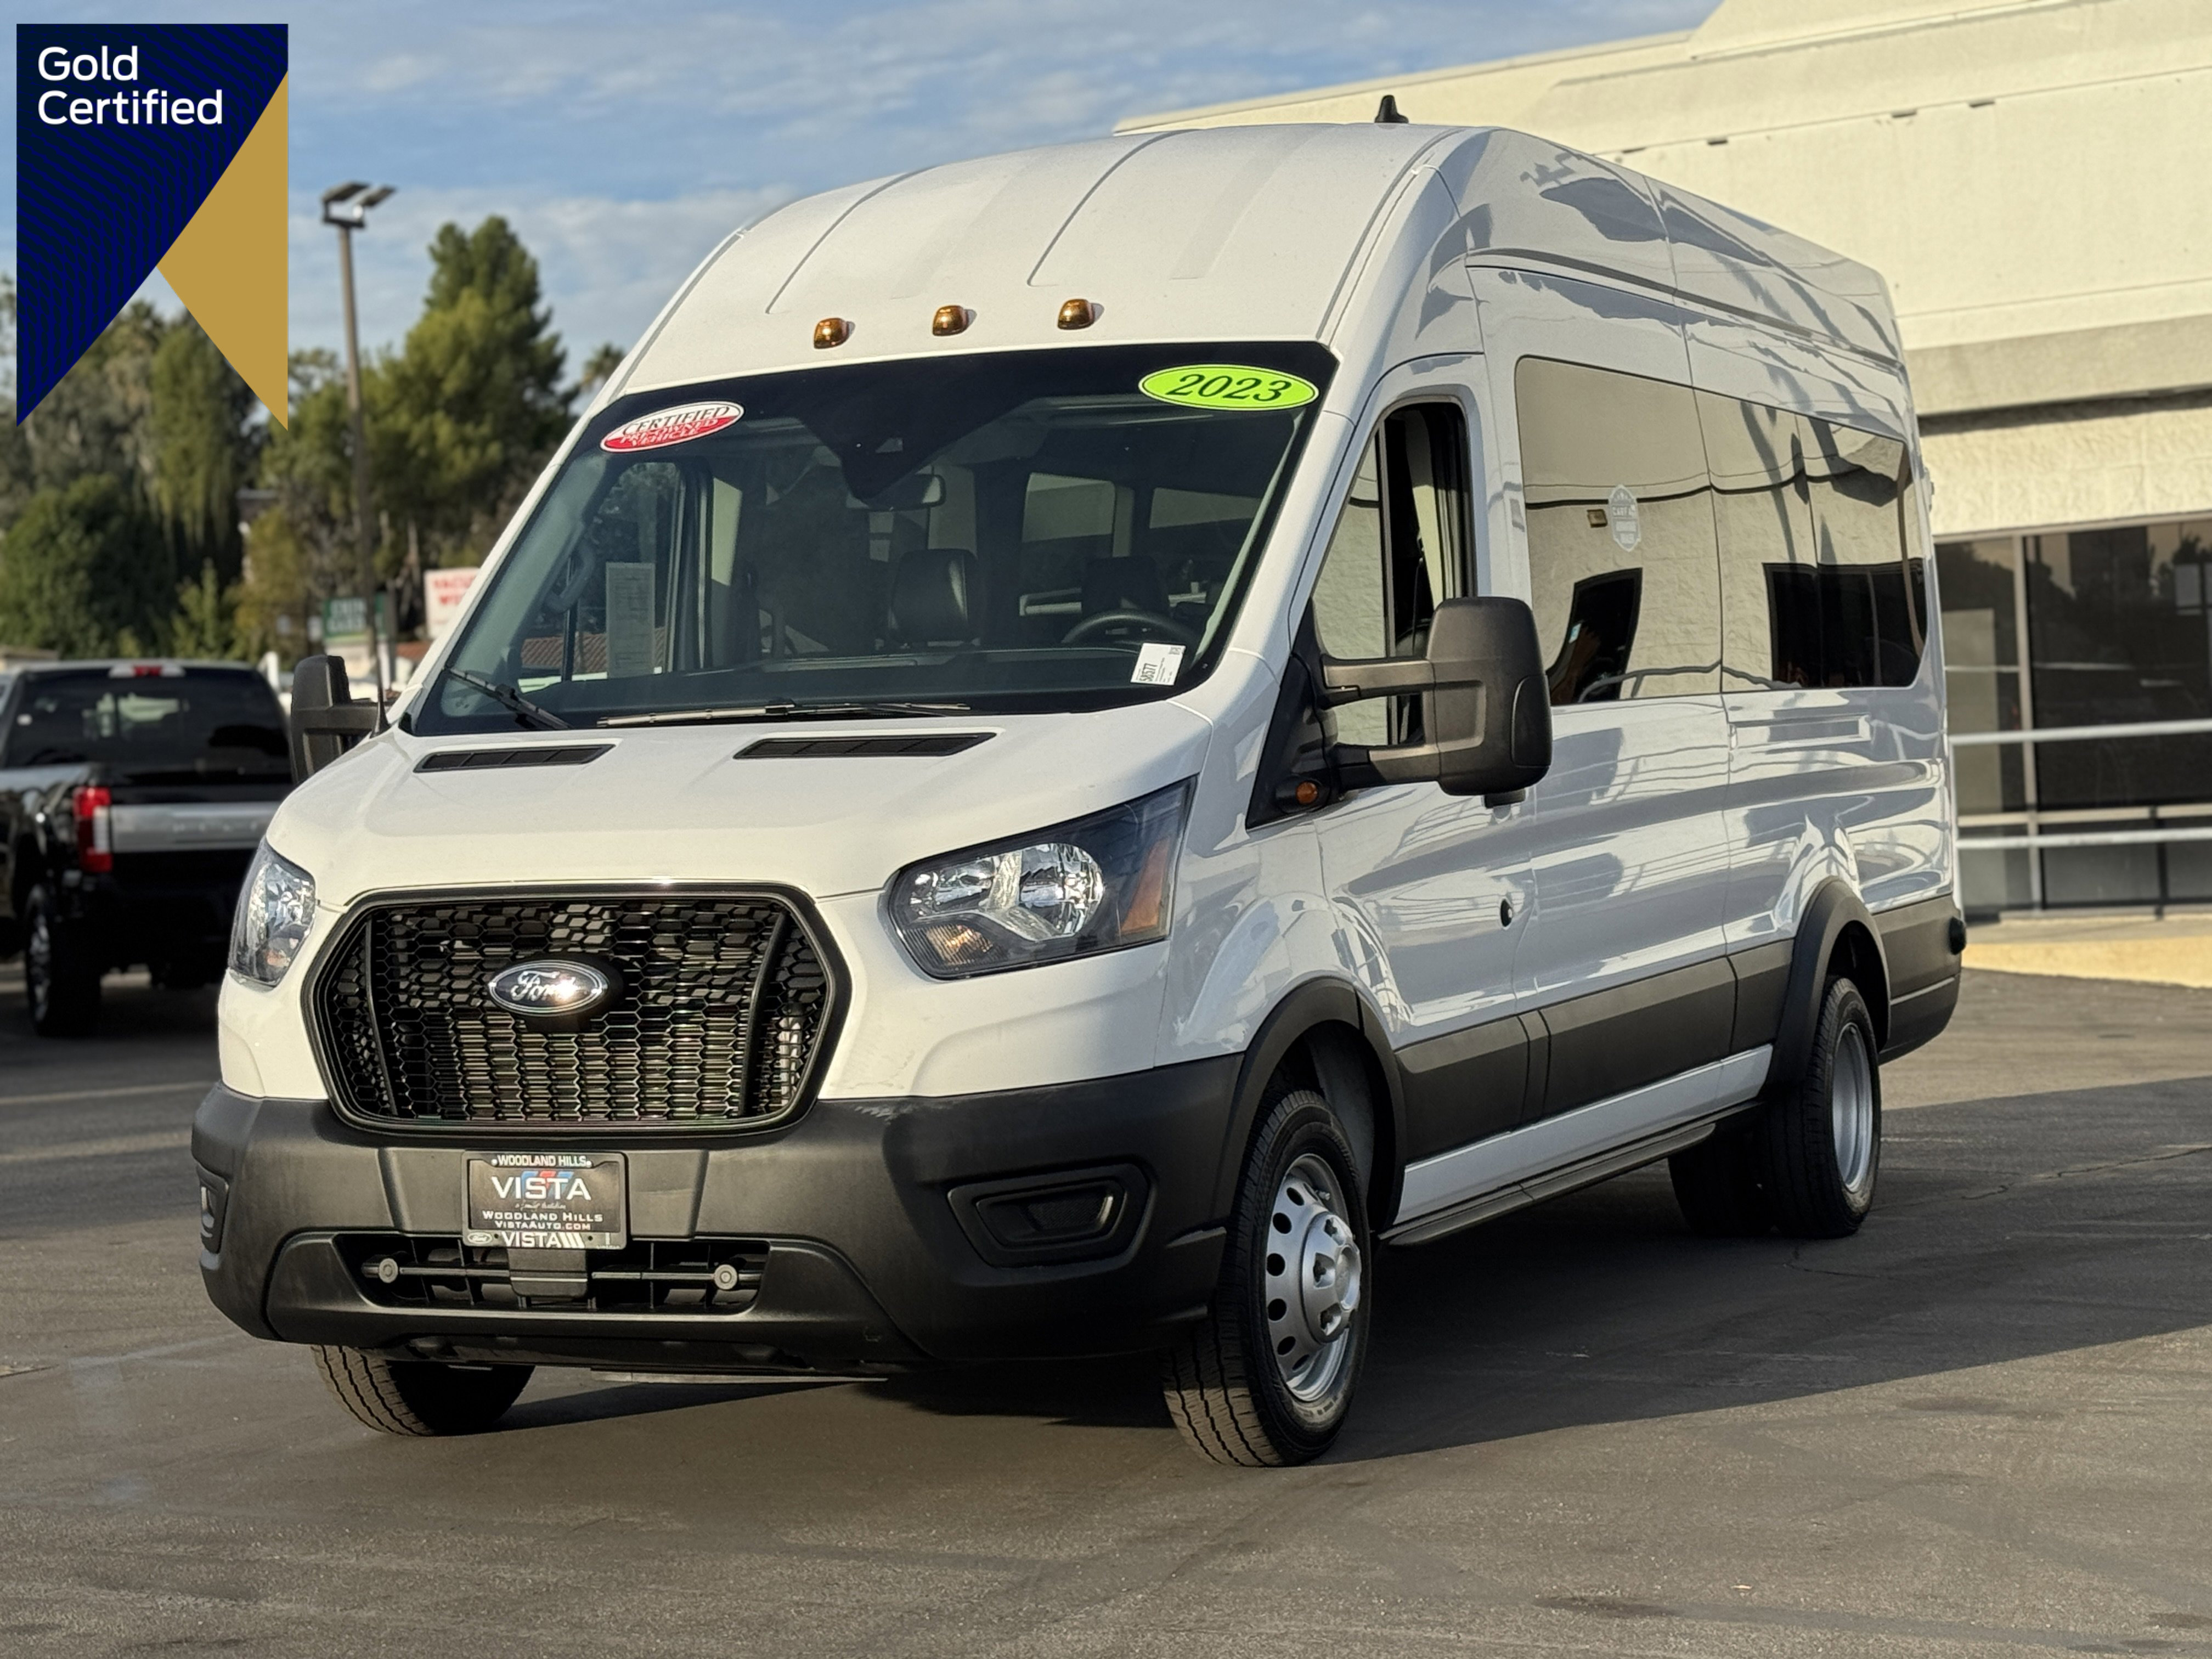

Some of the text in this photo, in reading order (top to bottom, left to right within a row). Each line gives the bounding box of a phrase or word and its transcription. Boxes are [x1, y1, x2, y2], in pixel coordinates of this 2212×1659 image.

[1164, 374, 1292, 402] 2023
[622, 406, 730, 436] CERTIFIED
[498, 1154, 586, 1167] WOODLAND HILLS
[492, 1177, 591, 1201] VISTA
[482, 1210, 603, 1222] WOODLAND HILLS
[501, 1231, 561, 1248] VISTA
